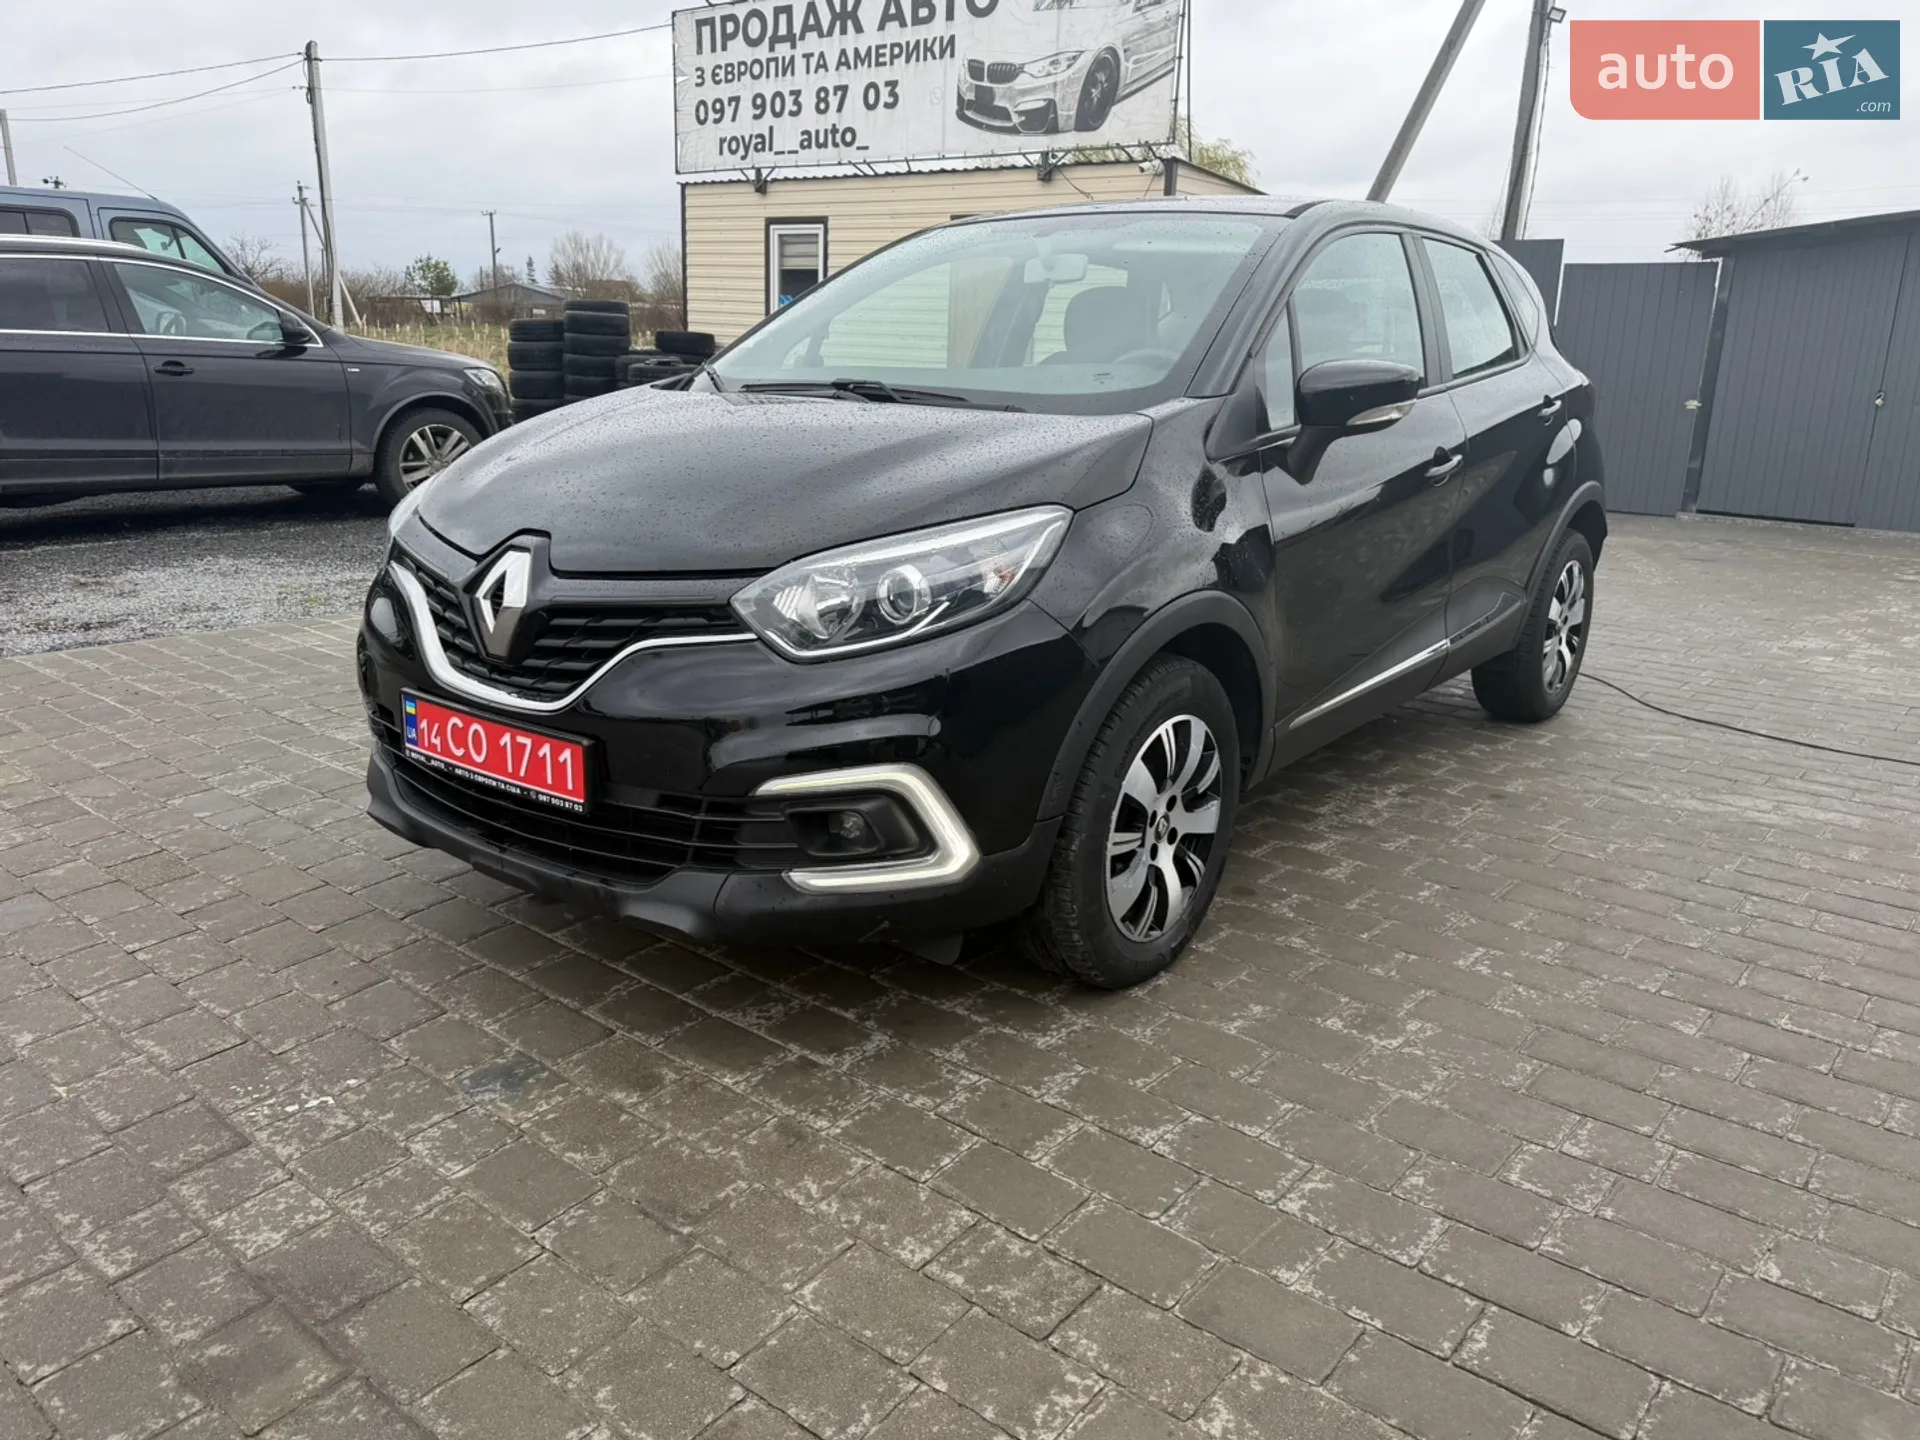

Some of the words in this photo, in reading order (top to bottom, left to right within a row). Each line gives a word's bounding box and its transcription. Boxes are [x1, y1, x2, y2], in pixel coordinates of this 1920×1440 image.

[695, 0, 865, 55] ПРОДАЖ
[711, 54, 796, 86] ЄВРОПИ
[802, 51, 829, 74] ТА
[835, 34, 956, 72] АМЕРИКИ
[695, 95, 741, 126] 097
[751, 89, 803, 120] 903
[815, 84, 849, 115] 87
[862, 79, 899, 111] 03
[499, 732, 573, 790] 1711
